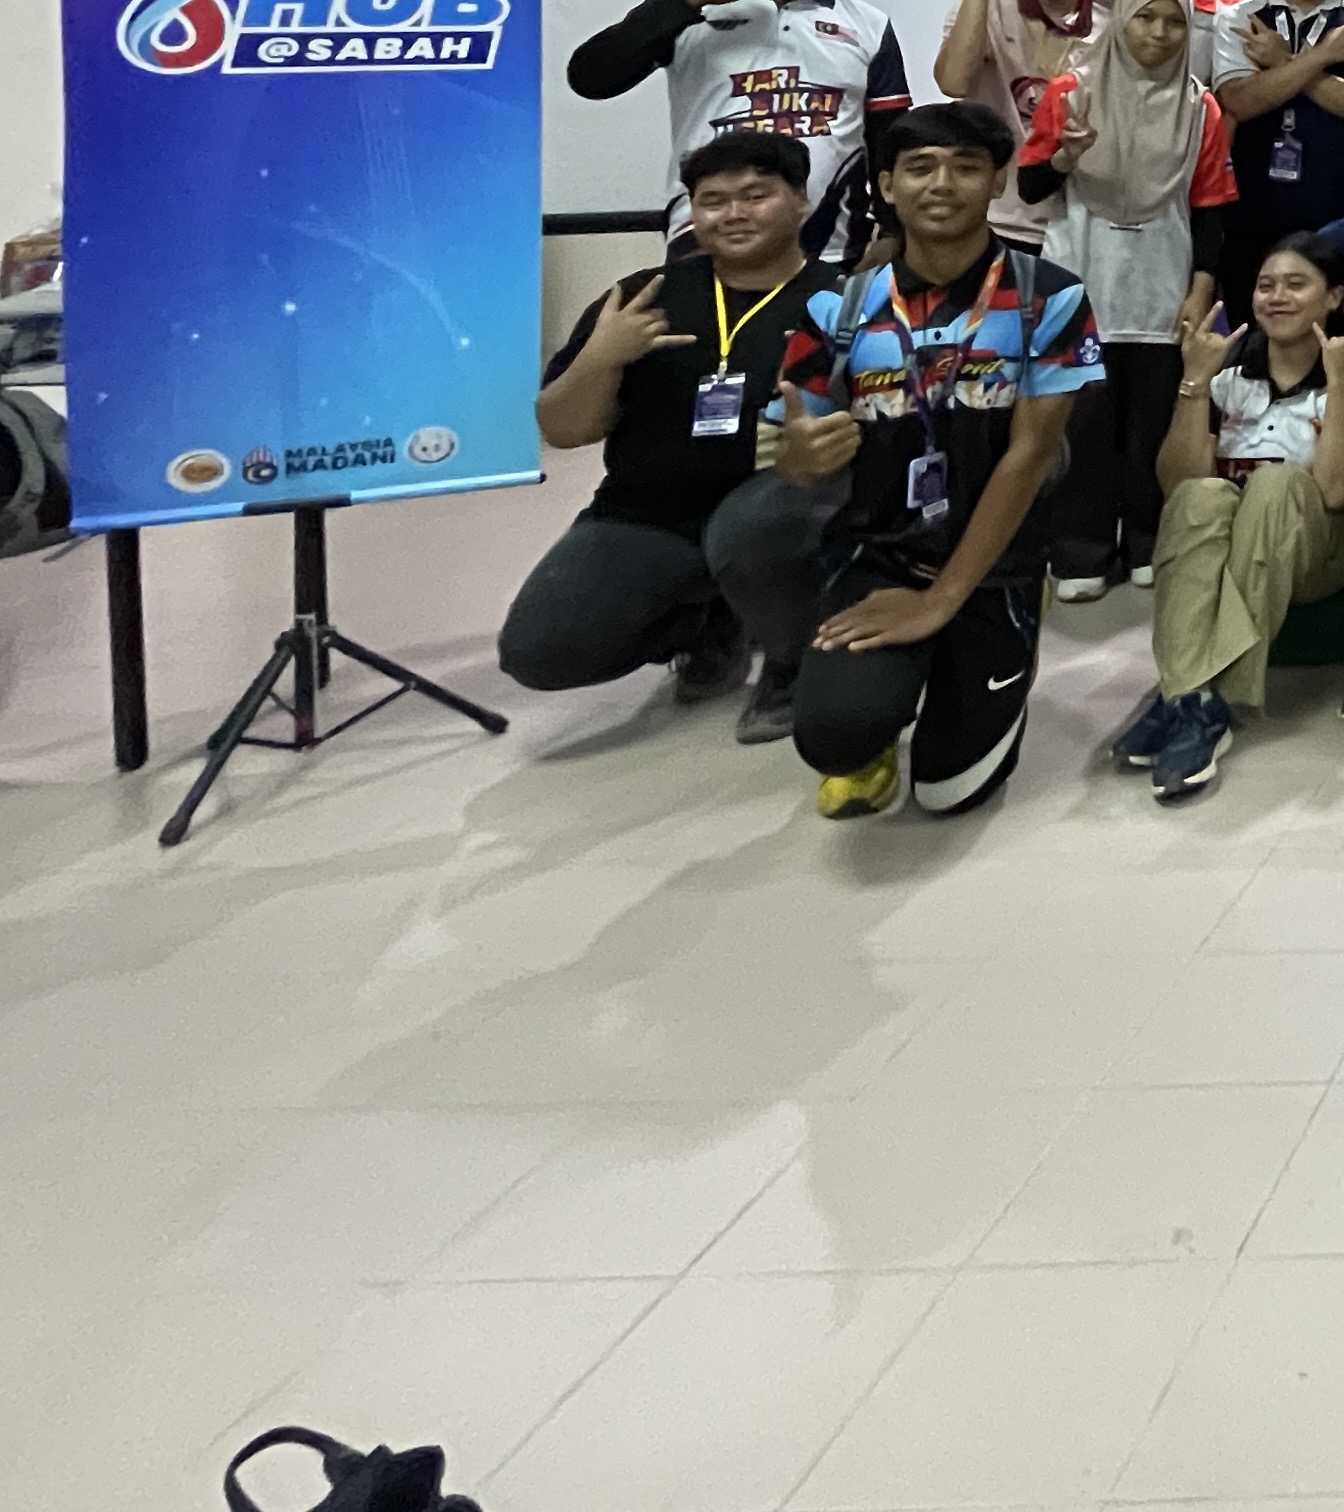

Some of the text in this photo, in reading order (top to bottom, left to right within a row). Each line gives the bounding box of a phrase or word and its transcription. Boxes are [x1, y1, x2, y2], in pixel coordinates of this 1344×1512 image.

[257, 37, 471, 64] @SABAH
[284, 437, 394, 458] MALAYSIA
[285, 451, 395, 476] MADANI
